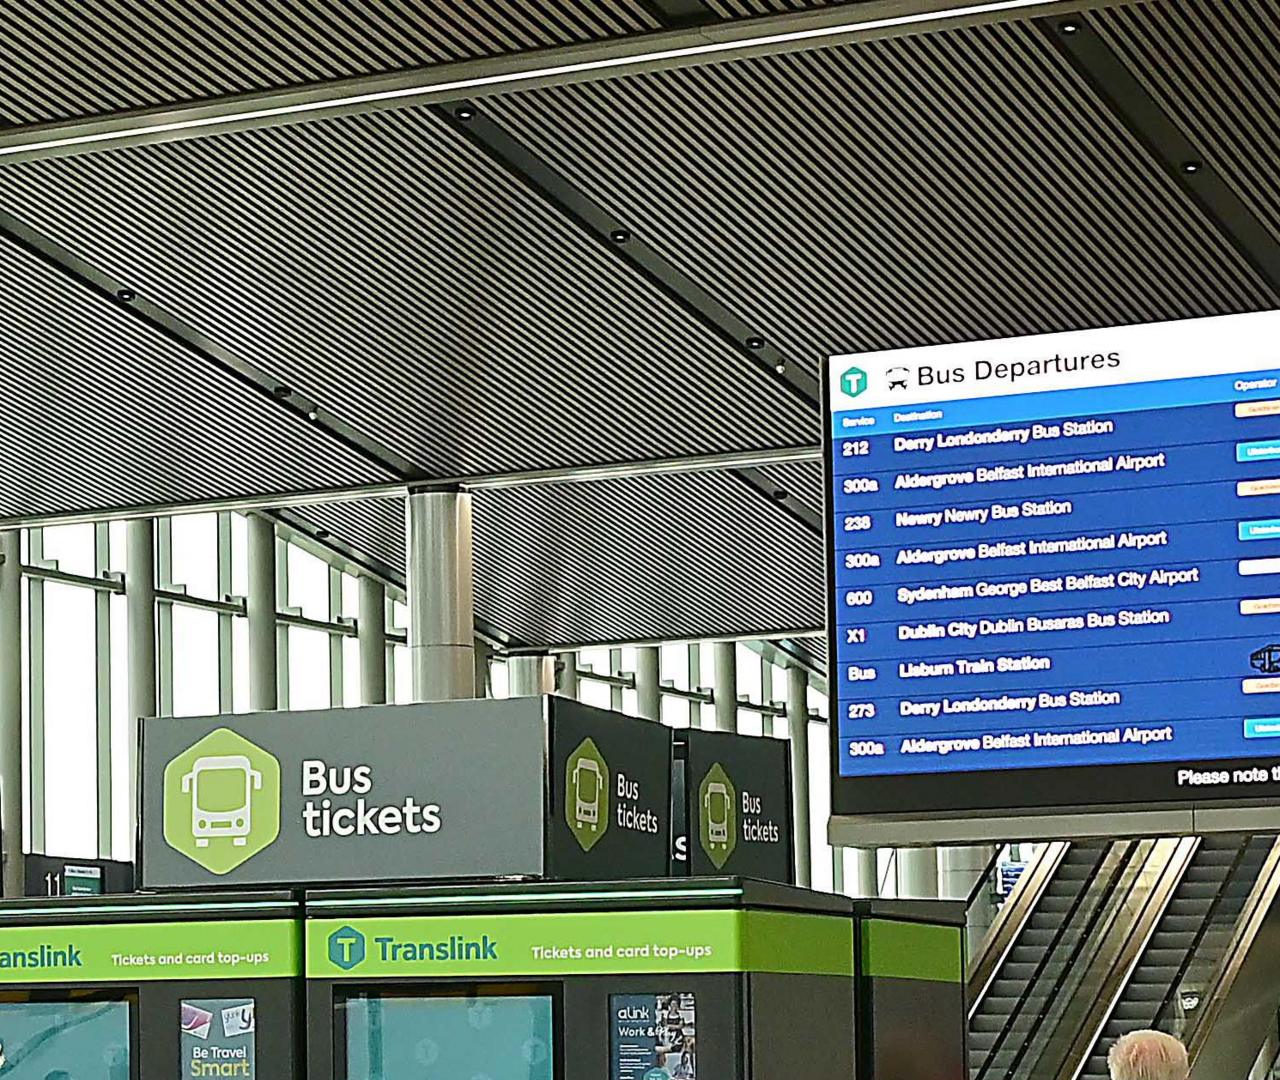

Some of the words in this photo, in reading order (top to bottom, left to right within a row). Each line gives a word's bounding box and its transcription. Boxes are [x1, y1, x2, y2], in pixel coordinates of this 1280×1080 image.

[918, 365, 965, 386] Bus
[975, 352, 1121, 383] Departures
[842, 440, 869, 457] 212
[894, 437, 935, 452] Derry
[936, 428, 1031, 448] Londonderry
[1032, 424, 1061, 440] Bus
[1062, 419, 1114, 437] Station
[843, 478, 879, 494] 300a
[894, 471, 975, 489] Aldergrove
[976, 465, 1025, 483] Belfast
[1027, 456, 1114, 478] International
[1115, 452, 1166, 472] Airport
[844, 515, 871, 531] 238
[895, 512, 943, 527] Newry
[944, 508, 989, 524] Newry
[991, 504, 1020, 520] Bus
[1021, 500, 1072, 517] Station
[845, 590, 873, 606] 600
[897, 584, 974, 605] Sydenham
[975, 581, 1028, 598] George
[1029, 577, 1064, 593] Best
[1065, 573, 1115, 591] Belfast
[1117, 571, 1147, 589] City
[1148, 567, 1199, 587] Airport
[846, 628, 865, 644] X1
[898, 623, 946, 640] Dublin
[947, 621, 978, 639] City
[979, 618, 1025, 635] Dublin
[1026, 616, 1085, 632] Busaras
[1086, 612, 1116, 628] Bus
[1118, 609, 1170, 626] Station
[848, 666, 877, 681] Bus
[899, 662, 955, 678] Lisburn
[955, 658, 995, 674] Train
[996, 655, 1051, 672] Station
[302, 760, 372, 796] Bus
[617, 773, 639, 801] Bus
[1177, 769, 1230, 786] Please
[1232, 767, 1269, 783] note
[742, 791, 761, 815] Bus
[302, 797, 441, 837] tickets
[616, 802, 658, 834] tickets
[742, 818, 779, 842] tickets
[111, 953, 156, 966] Tickets
[158, 952, 183, 965] and
[185, 951, 215, 965] card
[217, 951, 270, 967] top-ups
[374, 935, 498, 961] Translink
[531, 945, 583, 960] Tickets
[585, 945, 613, 959] and
[616, 944, 650, 958] card
[652, 943, 712, 961] top-ups
[618, 1026, 646, 1037] Work
[646, 1026, 655, 1037] &
[192, 1046, 209, 1059] Be
[210, 1045, 247, 1059] Travel
[190, 1058, 250, 1077] Smart
